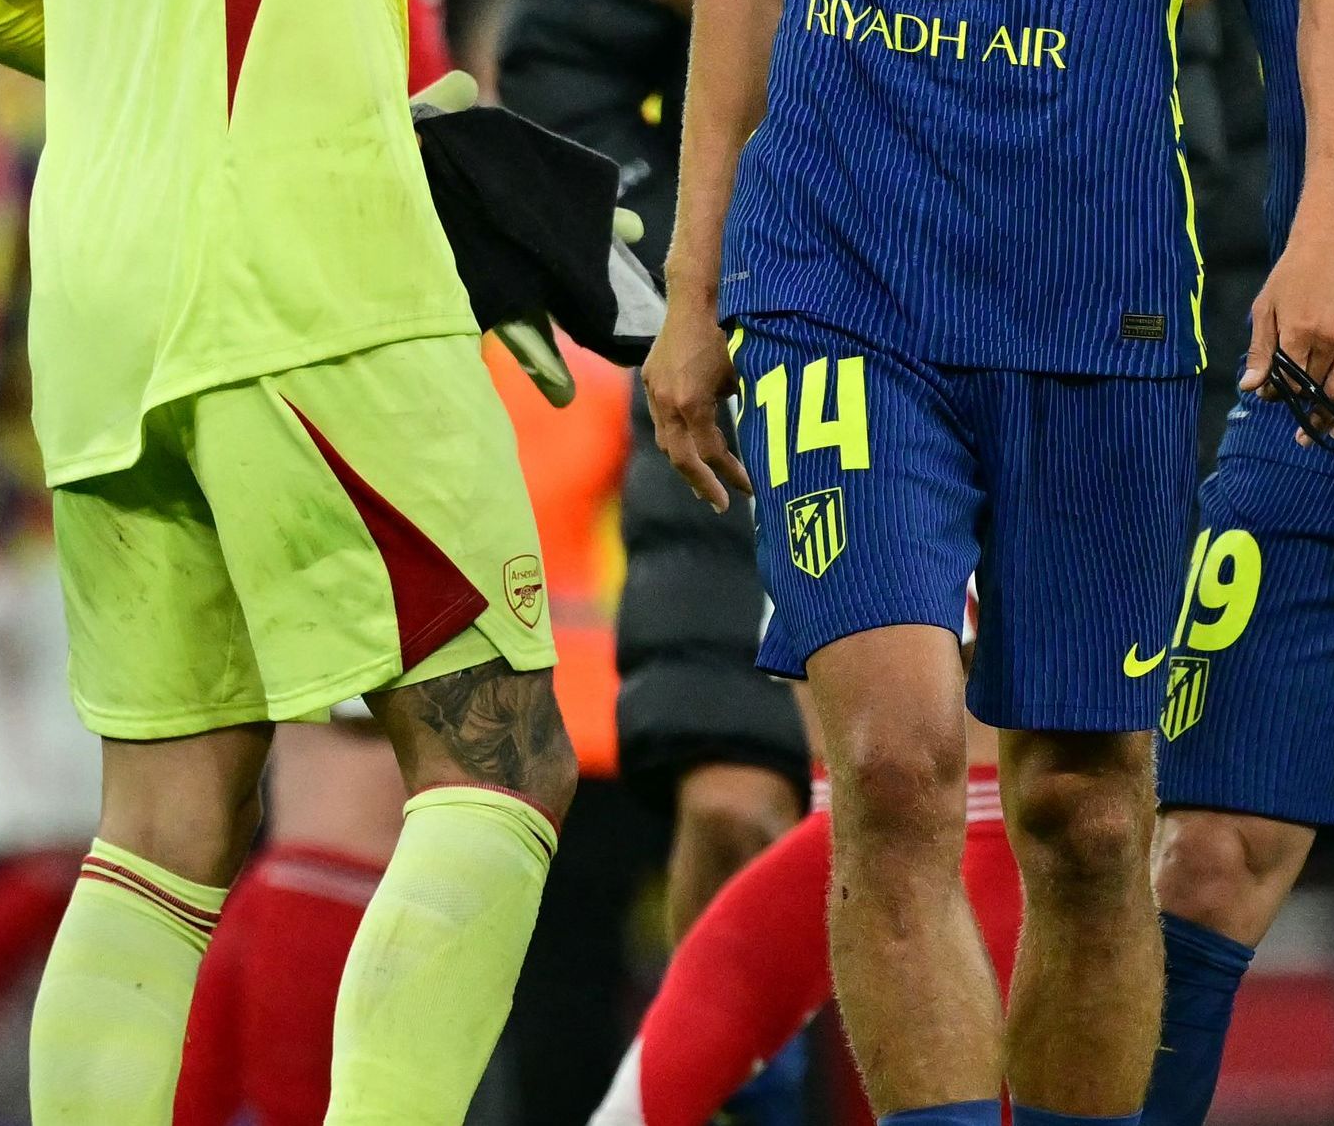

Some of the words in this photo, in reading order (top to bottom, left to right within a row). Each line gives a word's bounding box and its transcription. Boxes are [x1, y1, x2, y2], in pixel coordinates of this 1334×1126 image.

[981, 25, 1067, 69] AIR
[755, 355, 871, 489] 14
[1171, 527, 1263, 652] 19
